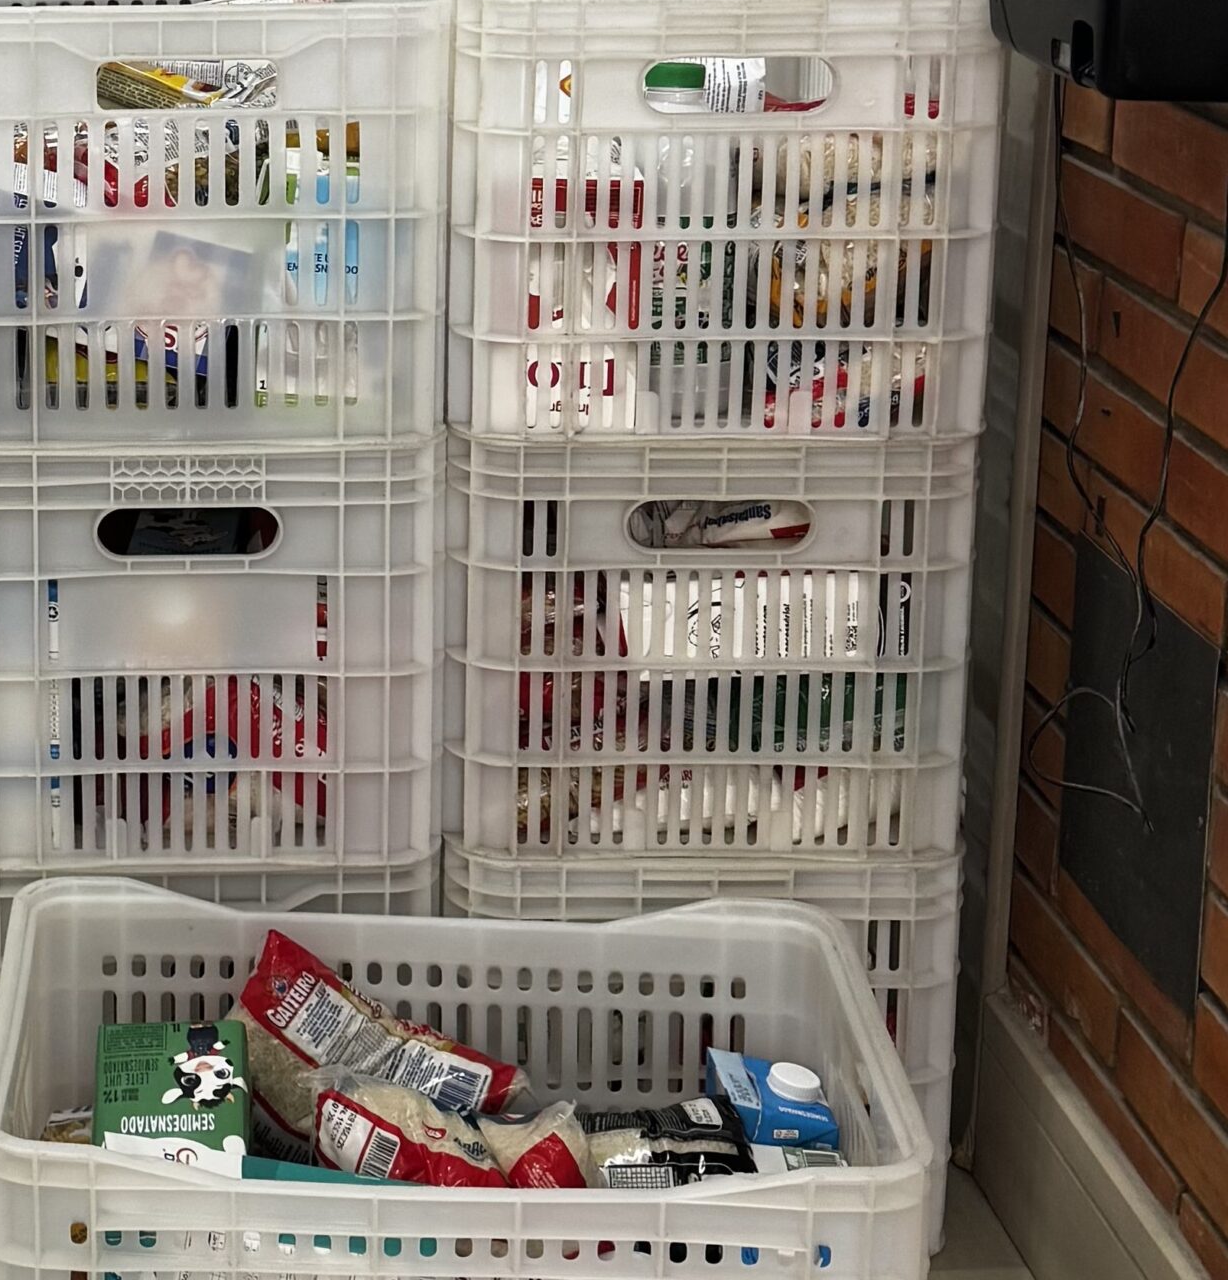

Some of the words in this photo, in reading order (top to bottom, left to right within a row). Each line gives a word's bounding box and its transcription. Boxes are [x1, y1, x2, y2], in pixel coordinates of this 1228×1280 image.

[265, 971, 316, 1029] GAITEIRO
[104, 1073, 122, 1087] UHT
[125, 1072, 149, 1085] LEITE
[104, 1089, 119, 1104] 1%
[120, 1113, 215, 1134] SEMIDESNATADO
